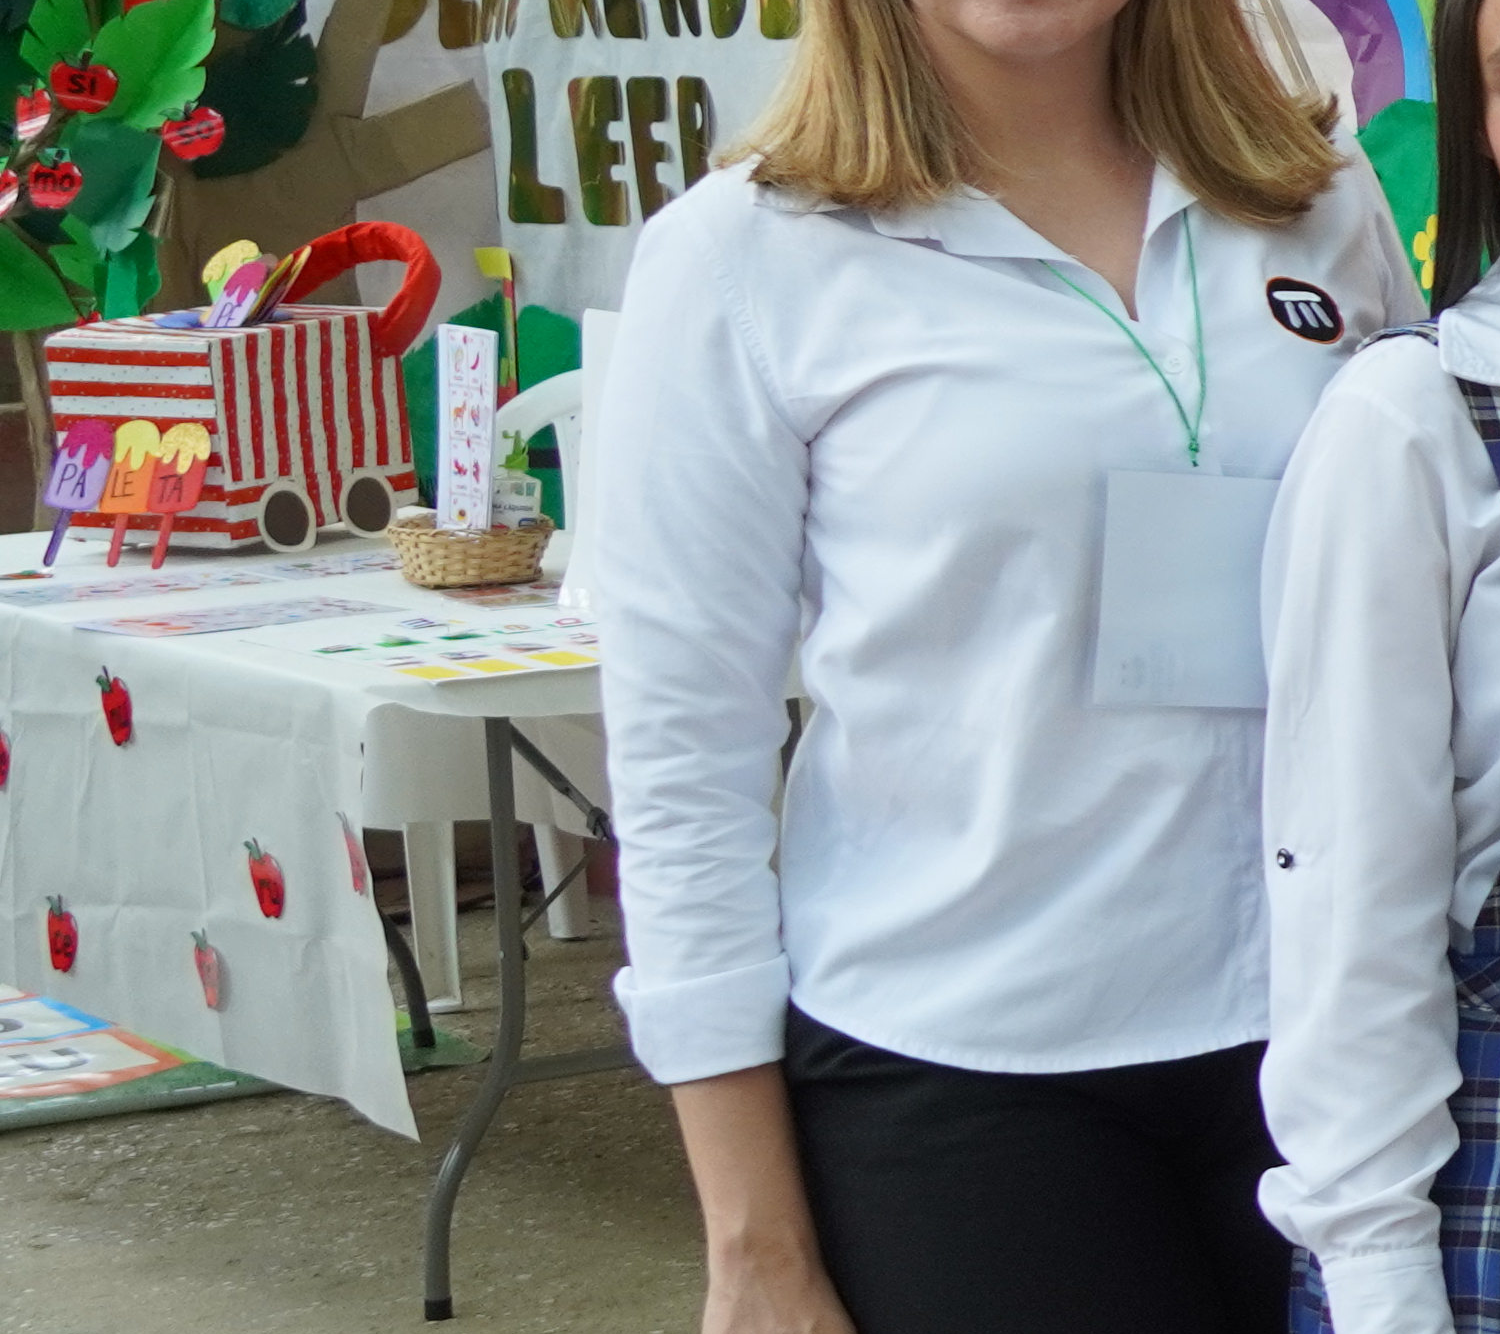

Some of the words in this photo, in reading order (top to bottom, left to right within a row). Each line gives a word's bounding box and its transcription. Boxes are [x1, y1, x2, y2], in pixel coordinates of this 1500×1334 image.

[55, 463, 87, 499] PA
[110, 469, 134, 498] LE
[158, 473, 184, 504] TA
